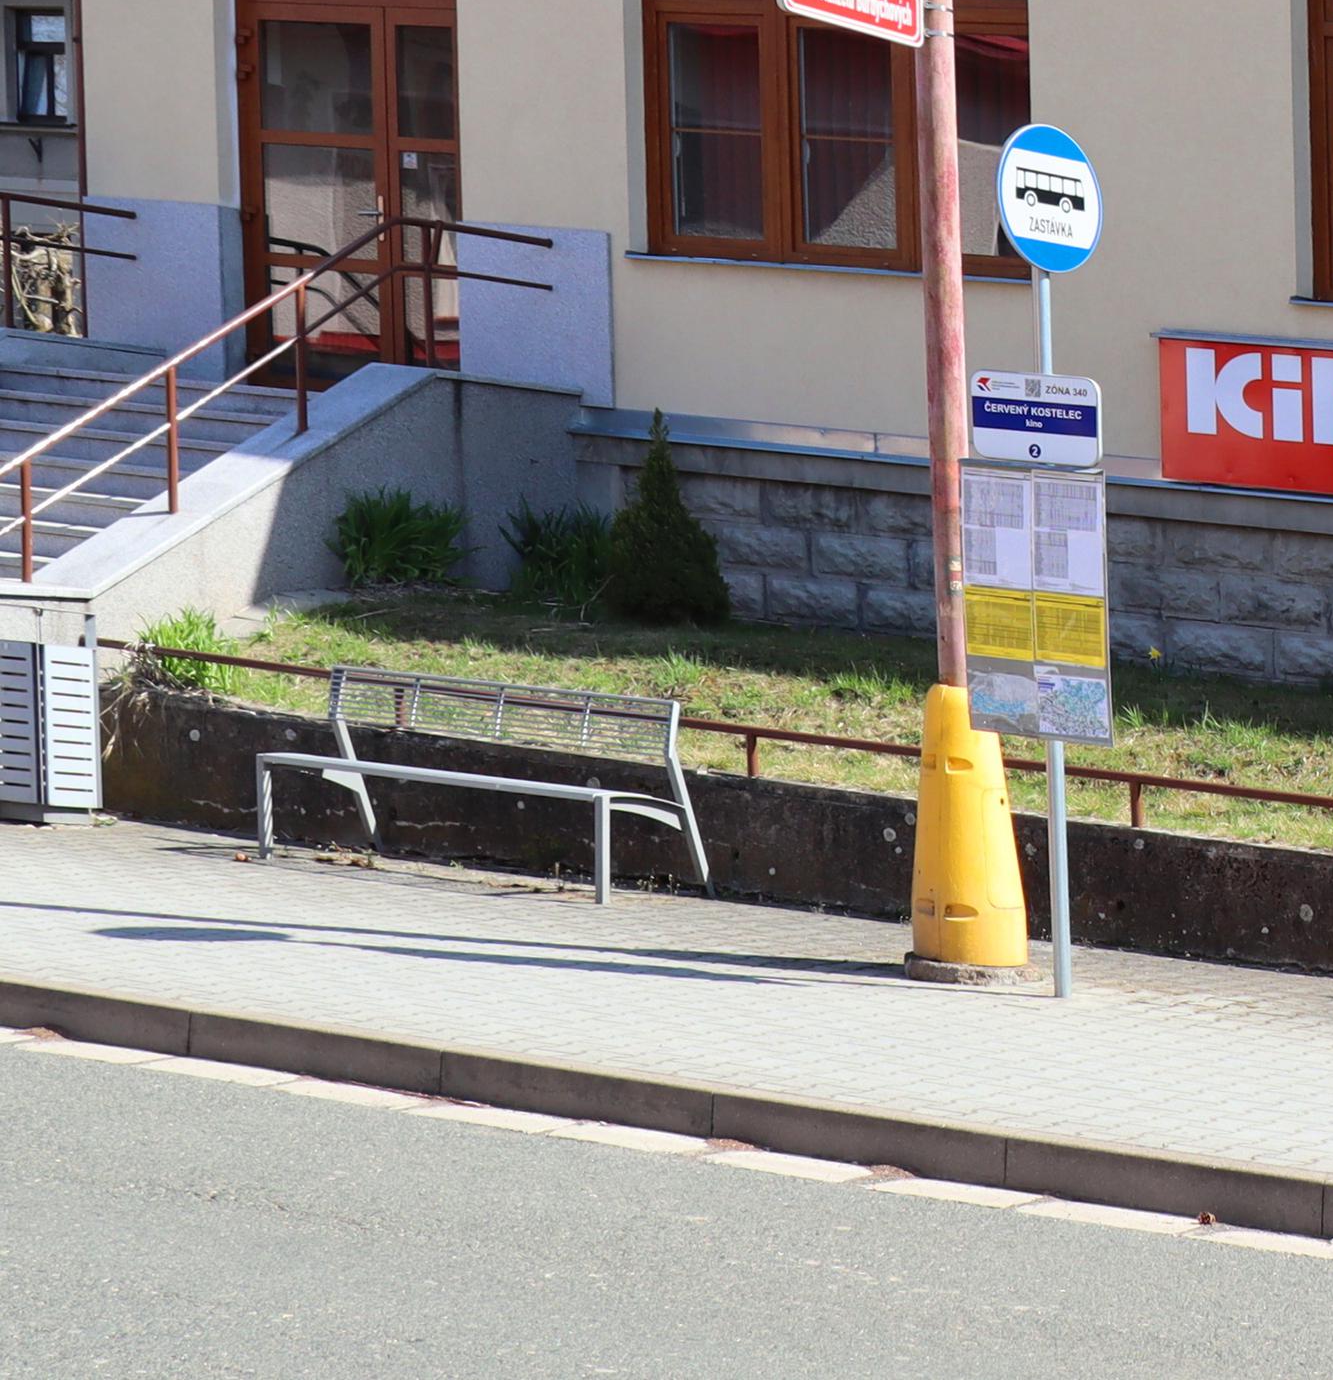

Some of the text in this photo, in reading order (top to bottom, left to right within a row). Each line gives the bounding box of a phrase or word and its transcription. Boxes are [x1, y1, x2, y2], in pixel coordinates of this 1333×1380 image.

[1029, 216, 1073, 238] ZASTÁVKA
[1045, 384, 1088, 397] ZÓNA 340
[984, 400, 1083, 421] ČERVENÝ KOSTELEC
[1025, 419, 1043, 429] kino
